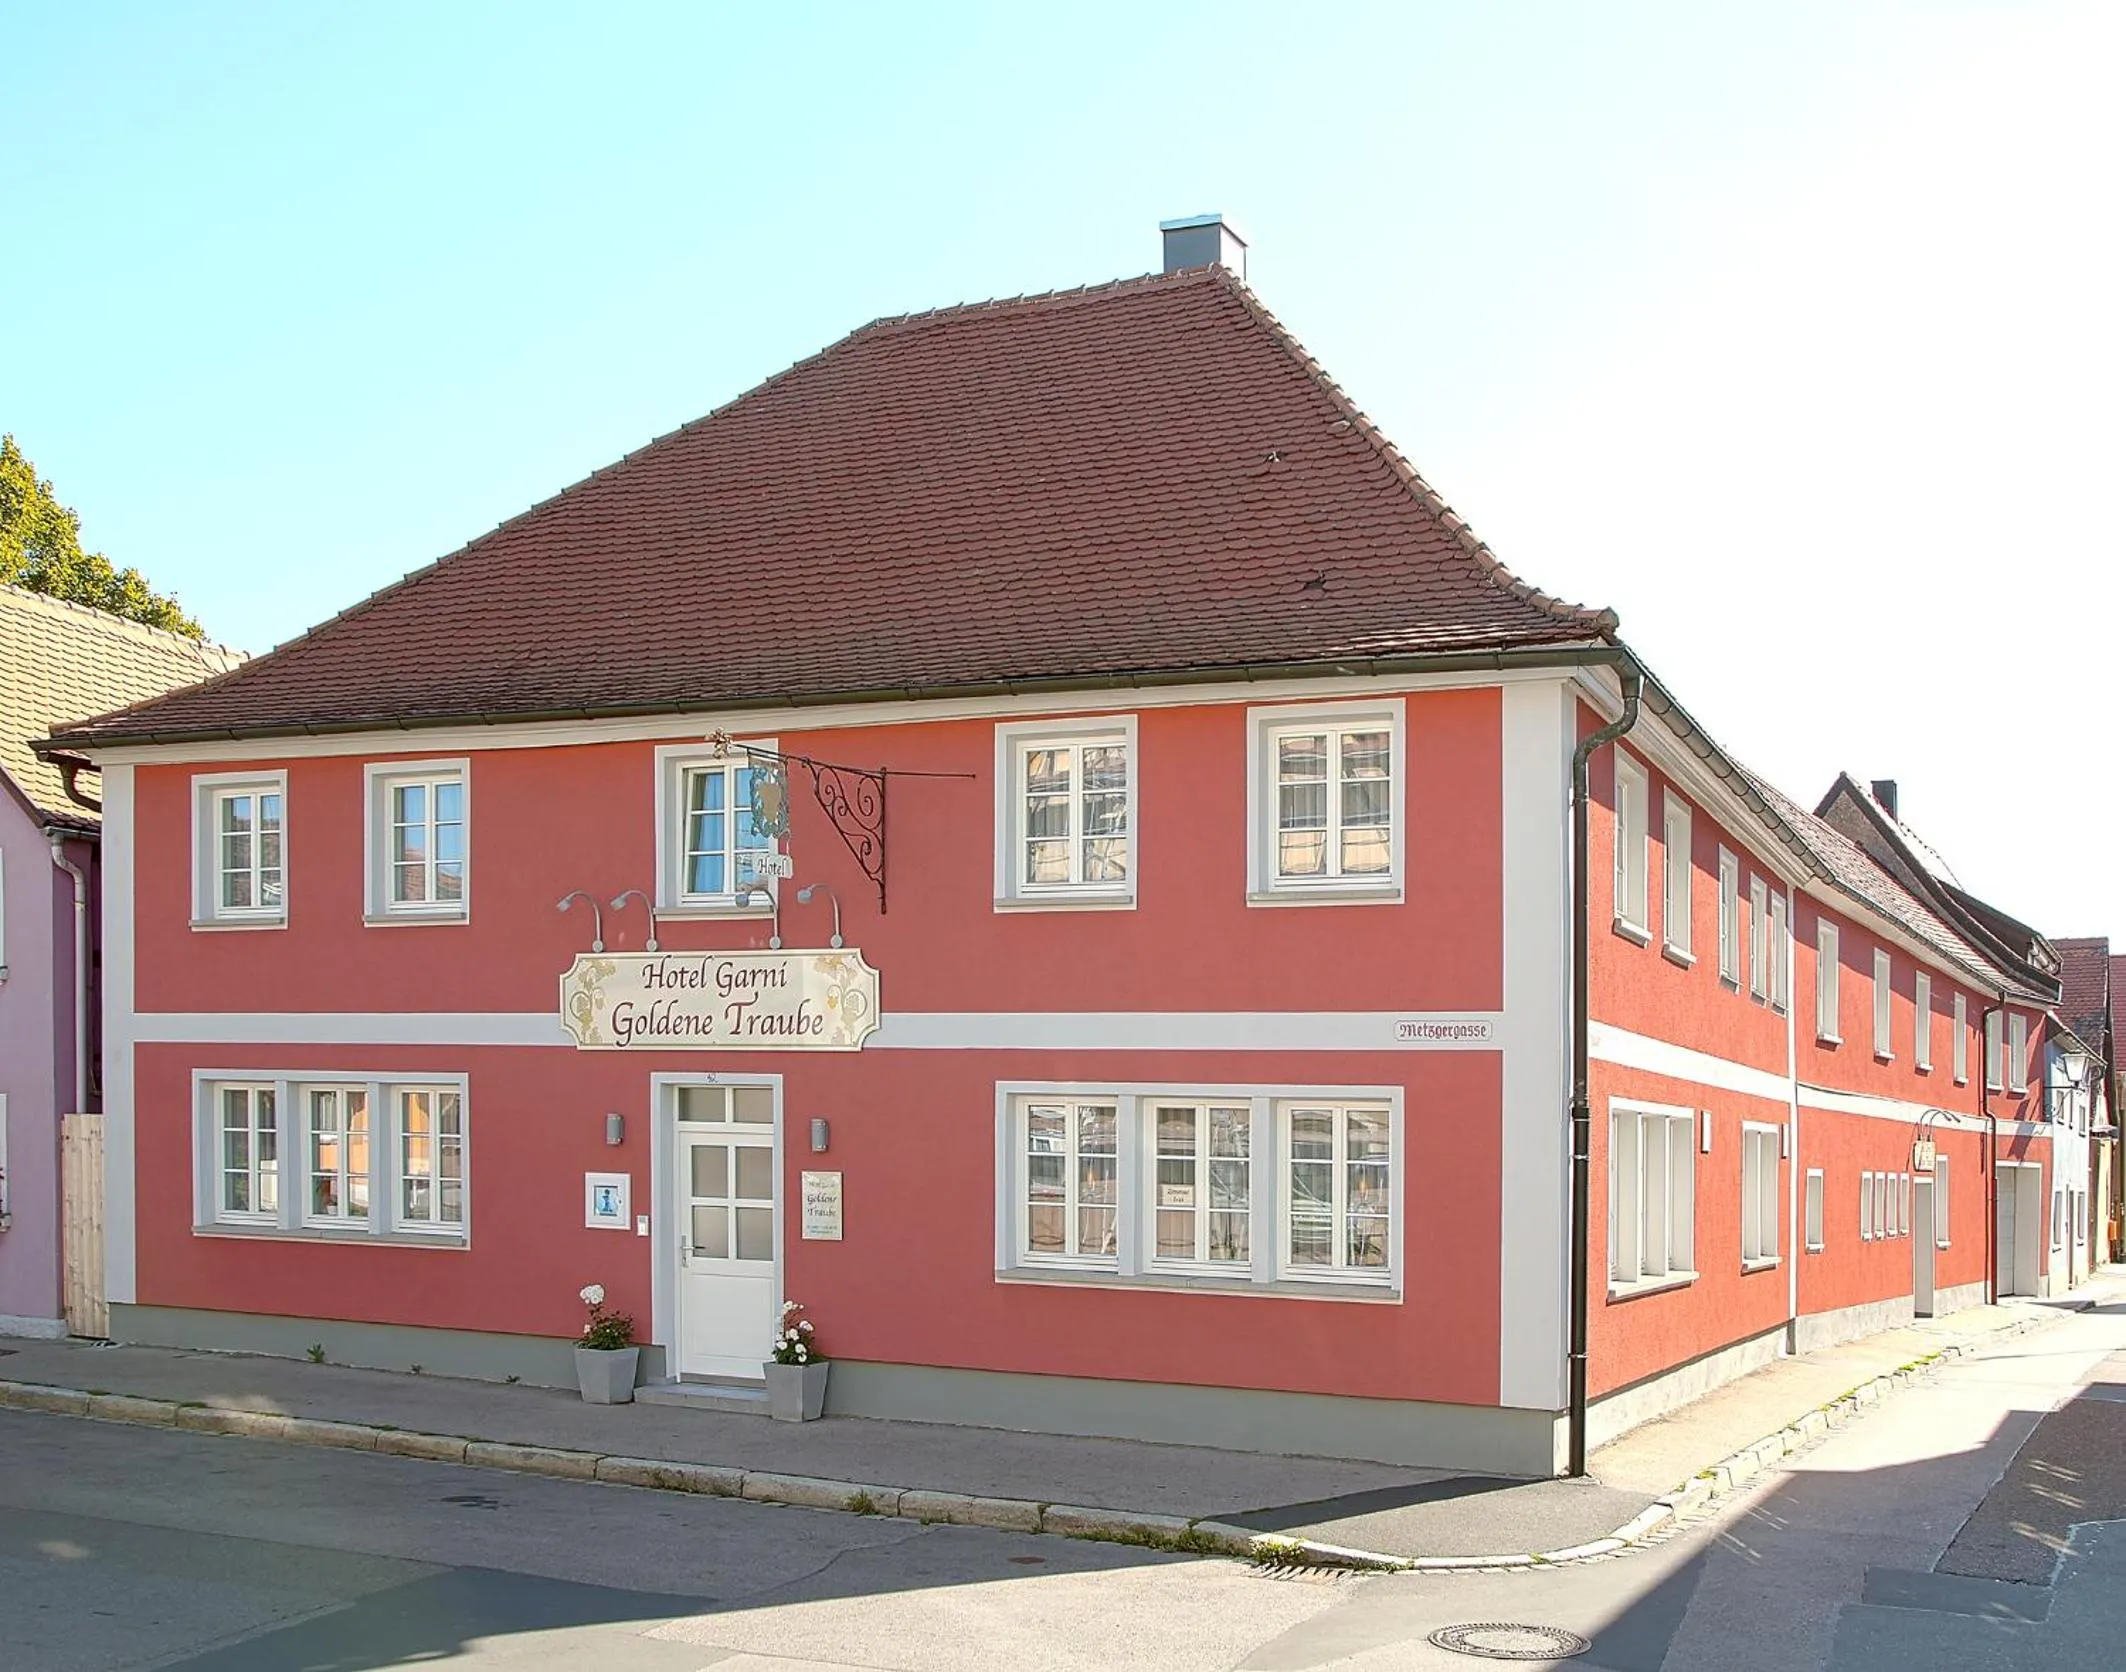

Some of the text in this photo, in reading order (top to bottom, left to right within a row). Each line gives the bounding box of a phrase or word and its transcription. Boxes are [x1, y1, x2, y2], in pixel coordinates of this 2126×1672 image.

[758, 857, 785, 876] Hotel
[642, 955, 788, 998] Hotel Garni
[611, 991, 824, 1047] Goldene Traube
[1399, 1023, 1487, 1040] Metzgergasse
